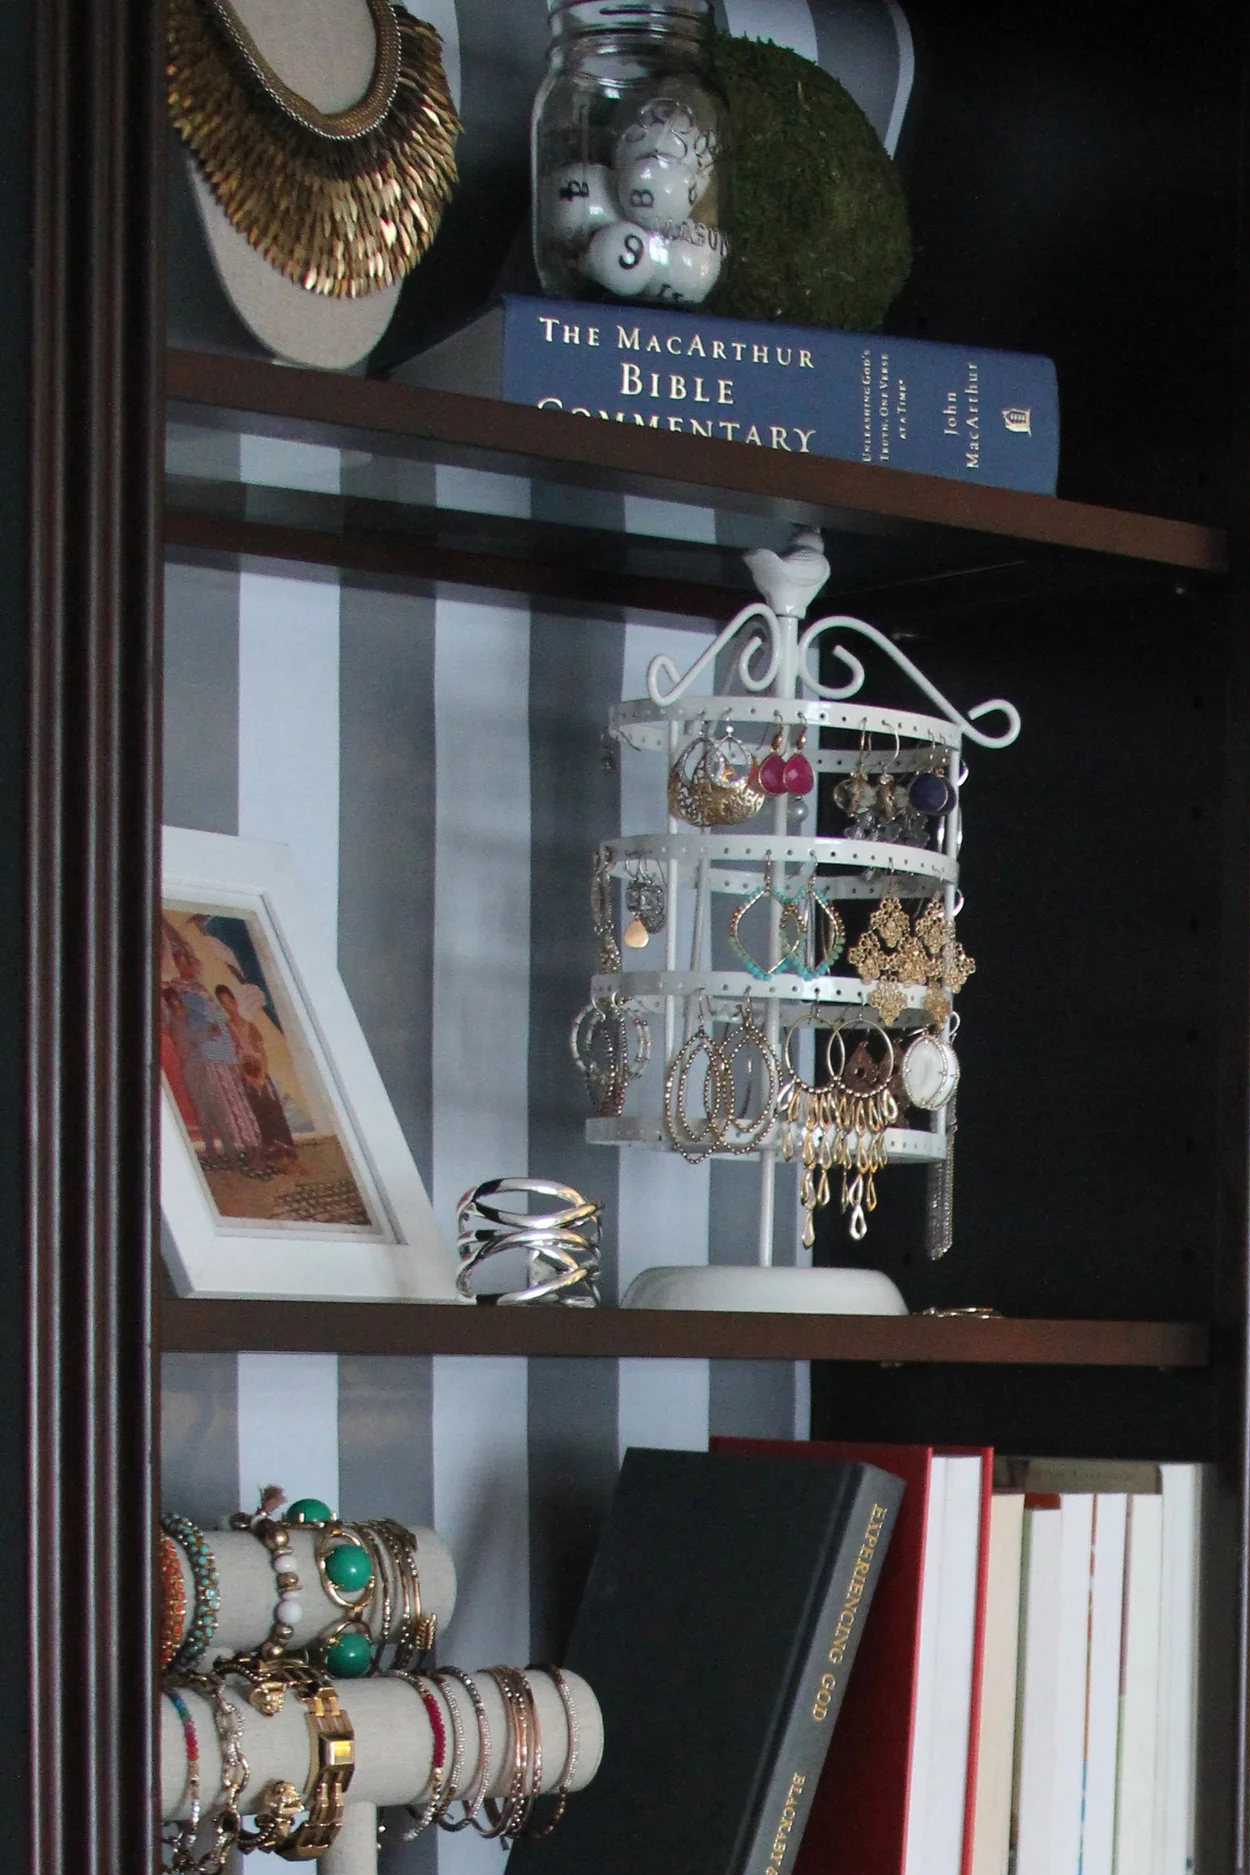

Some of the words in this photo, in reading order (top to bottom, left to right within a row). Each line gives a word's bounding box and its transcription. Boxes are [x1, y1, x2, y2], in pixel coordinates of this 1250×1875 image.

[539, 317, 600, 347] THE
[617, 325, 814, 369] MACARTHUR
[862, 349, 872, 385] GOD'S
[620, 362, 735, 405] BIBLE
[879, 353, 889, 389] VERSE
[537, 397, 816, 453] MENTARY
[862, 386, 872, 463] UNLEASHING
[879, 392, 889, 417] ONE
[943, 392, 960, 436] John
[965, 362, 980, 469] MacArthur
[829, 1503, 888, 1665] EXPERIENCING
[812, 1673, 837, 1722] GOD
[770, 1772, 806, 1866] BLACKABY
